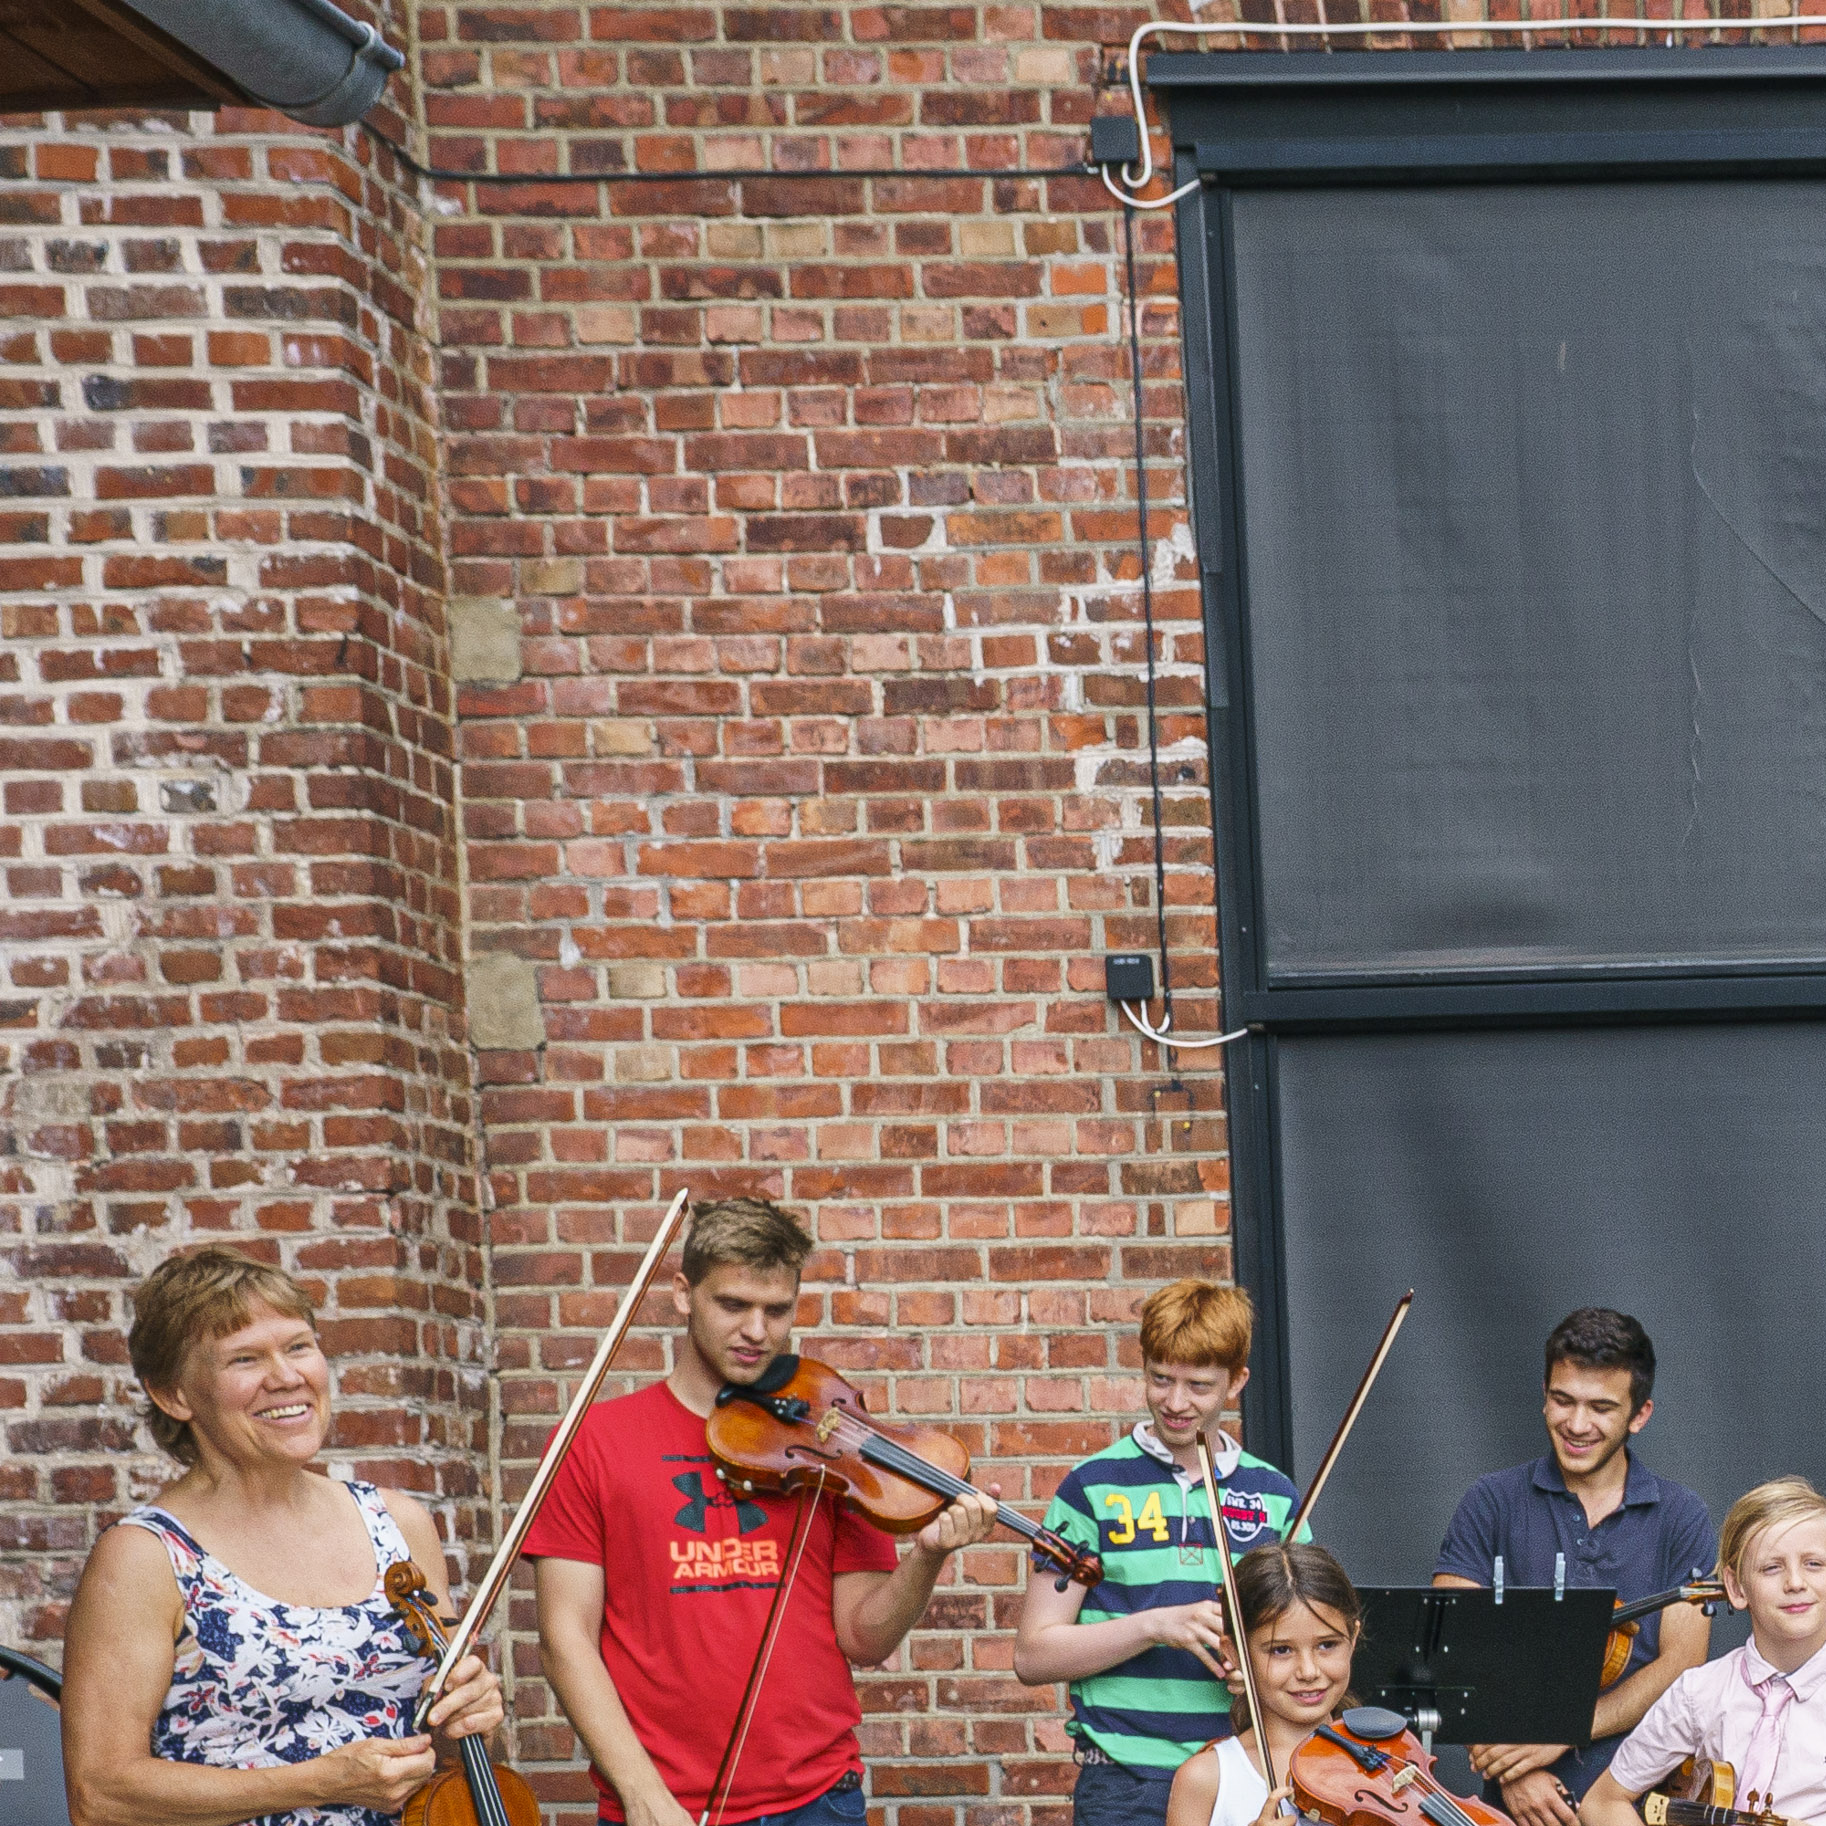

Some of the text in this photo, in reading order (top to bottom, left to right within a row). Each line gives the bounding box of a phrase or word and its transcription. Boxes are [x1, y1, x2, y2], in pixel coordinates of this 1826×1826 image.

[1104, 1491, 1170, 1545] 34
[669, 1537, 779, 1563] UNDER
[672, 1558, 780, 1579] ARMOUR
